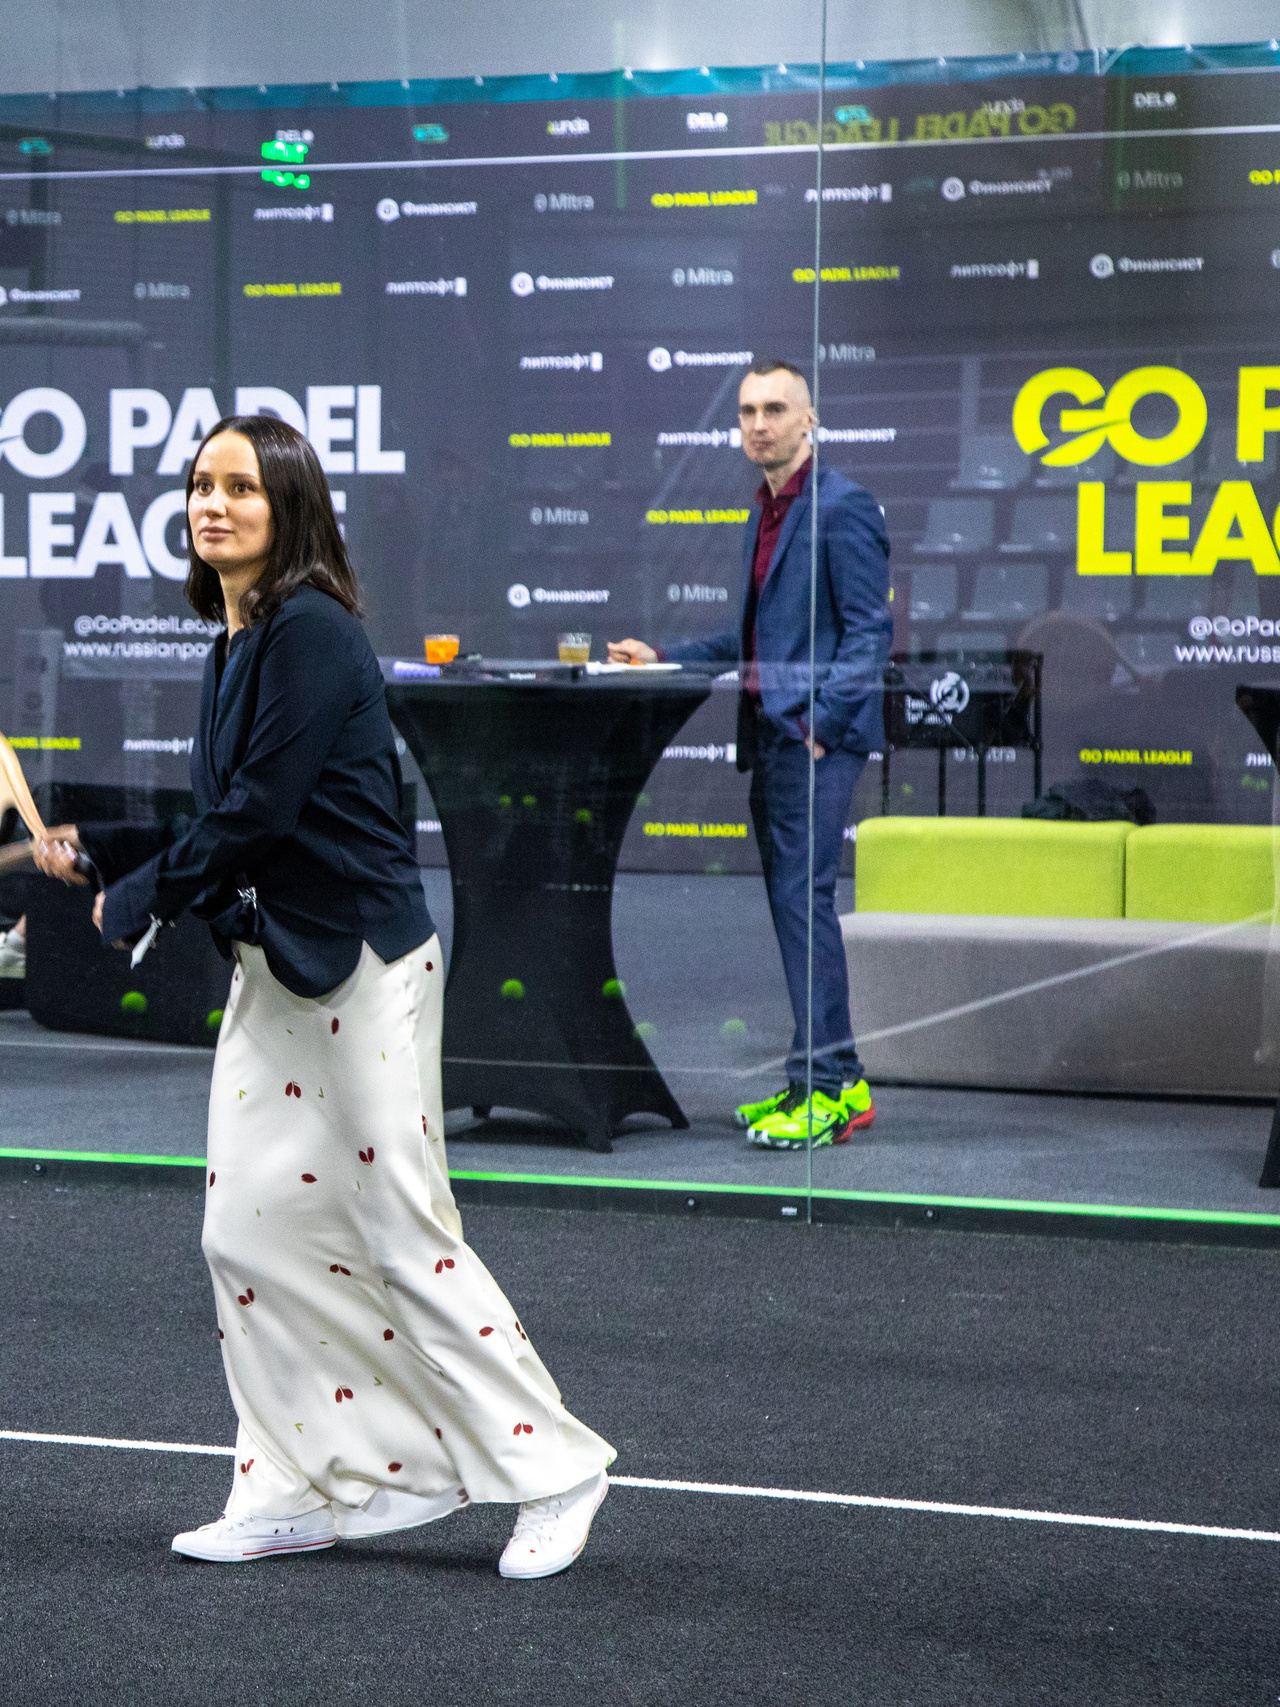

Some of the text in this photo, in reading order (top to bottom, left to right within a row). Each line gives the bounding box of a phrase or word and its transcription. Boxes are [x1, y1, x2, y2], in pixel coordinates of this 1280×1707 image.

[1012, 366, 1208, 467] GO
[1077, 481, 1280, 576] LEA
[74, 615, 224, 638] @GoPadelLeag
[63, 642, 213, 662] www.russianpa
[1079, 749, 1102, 765] GO
